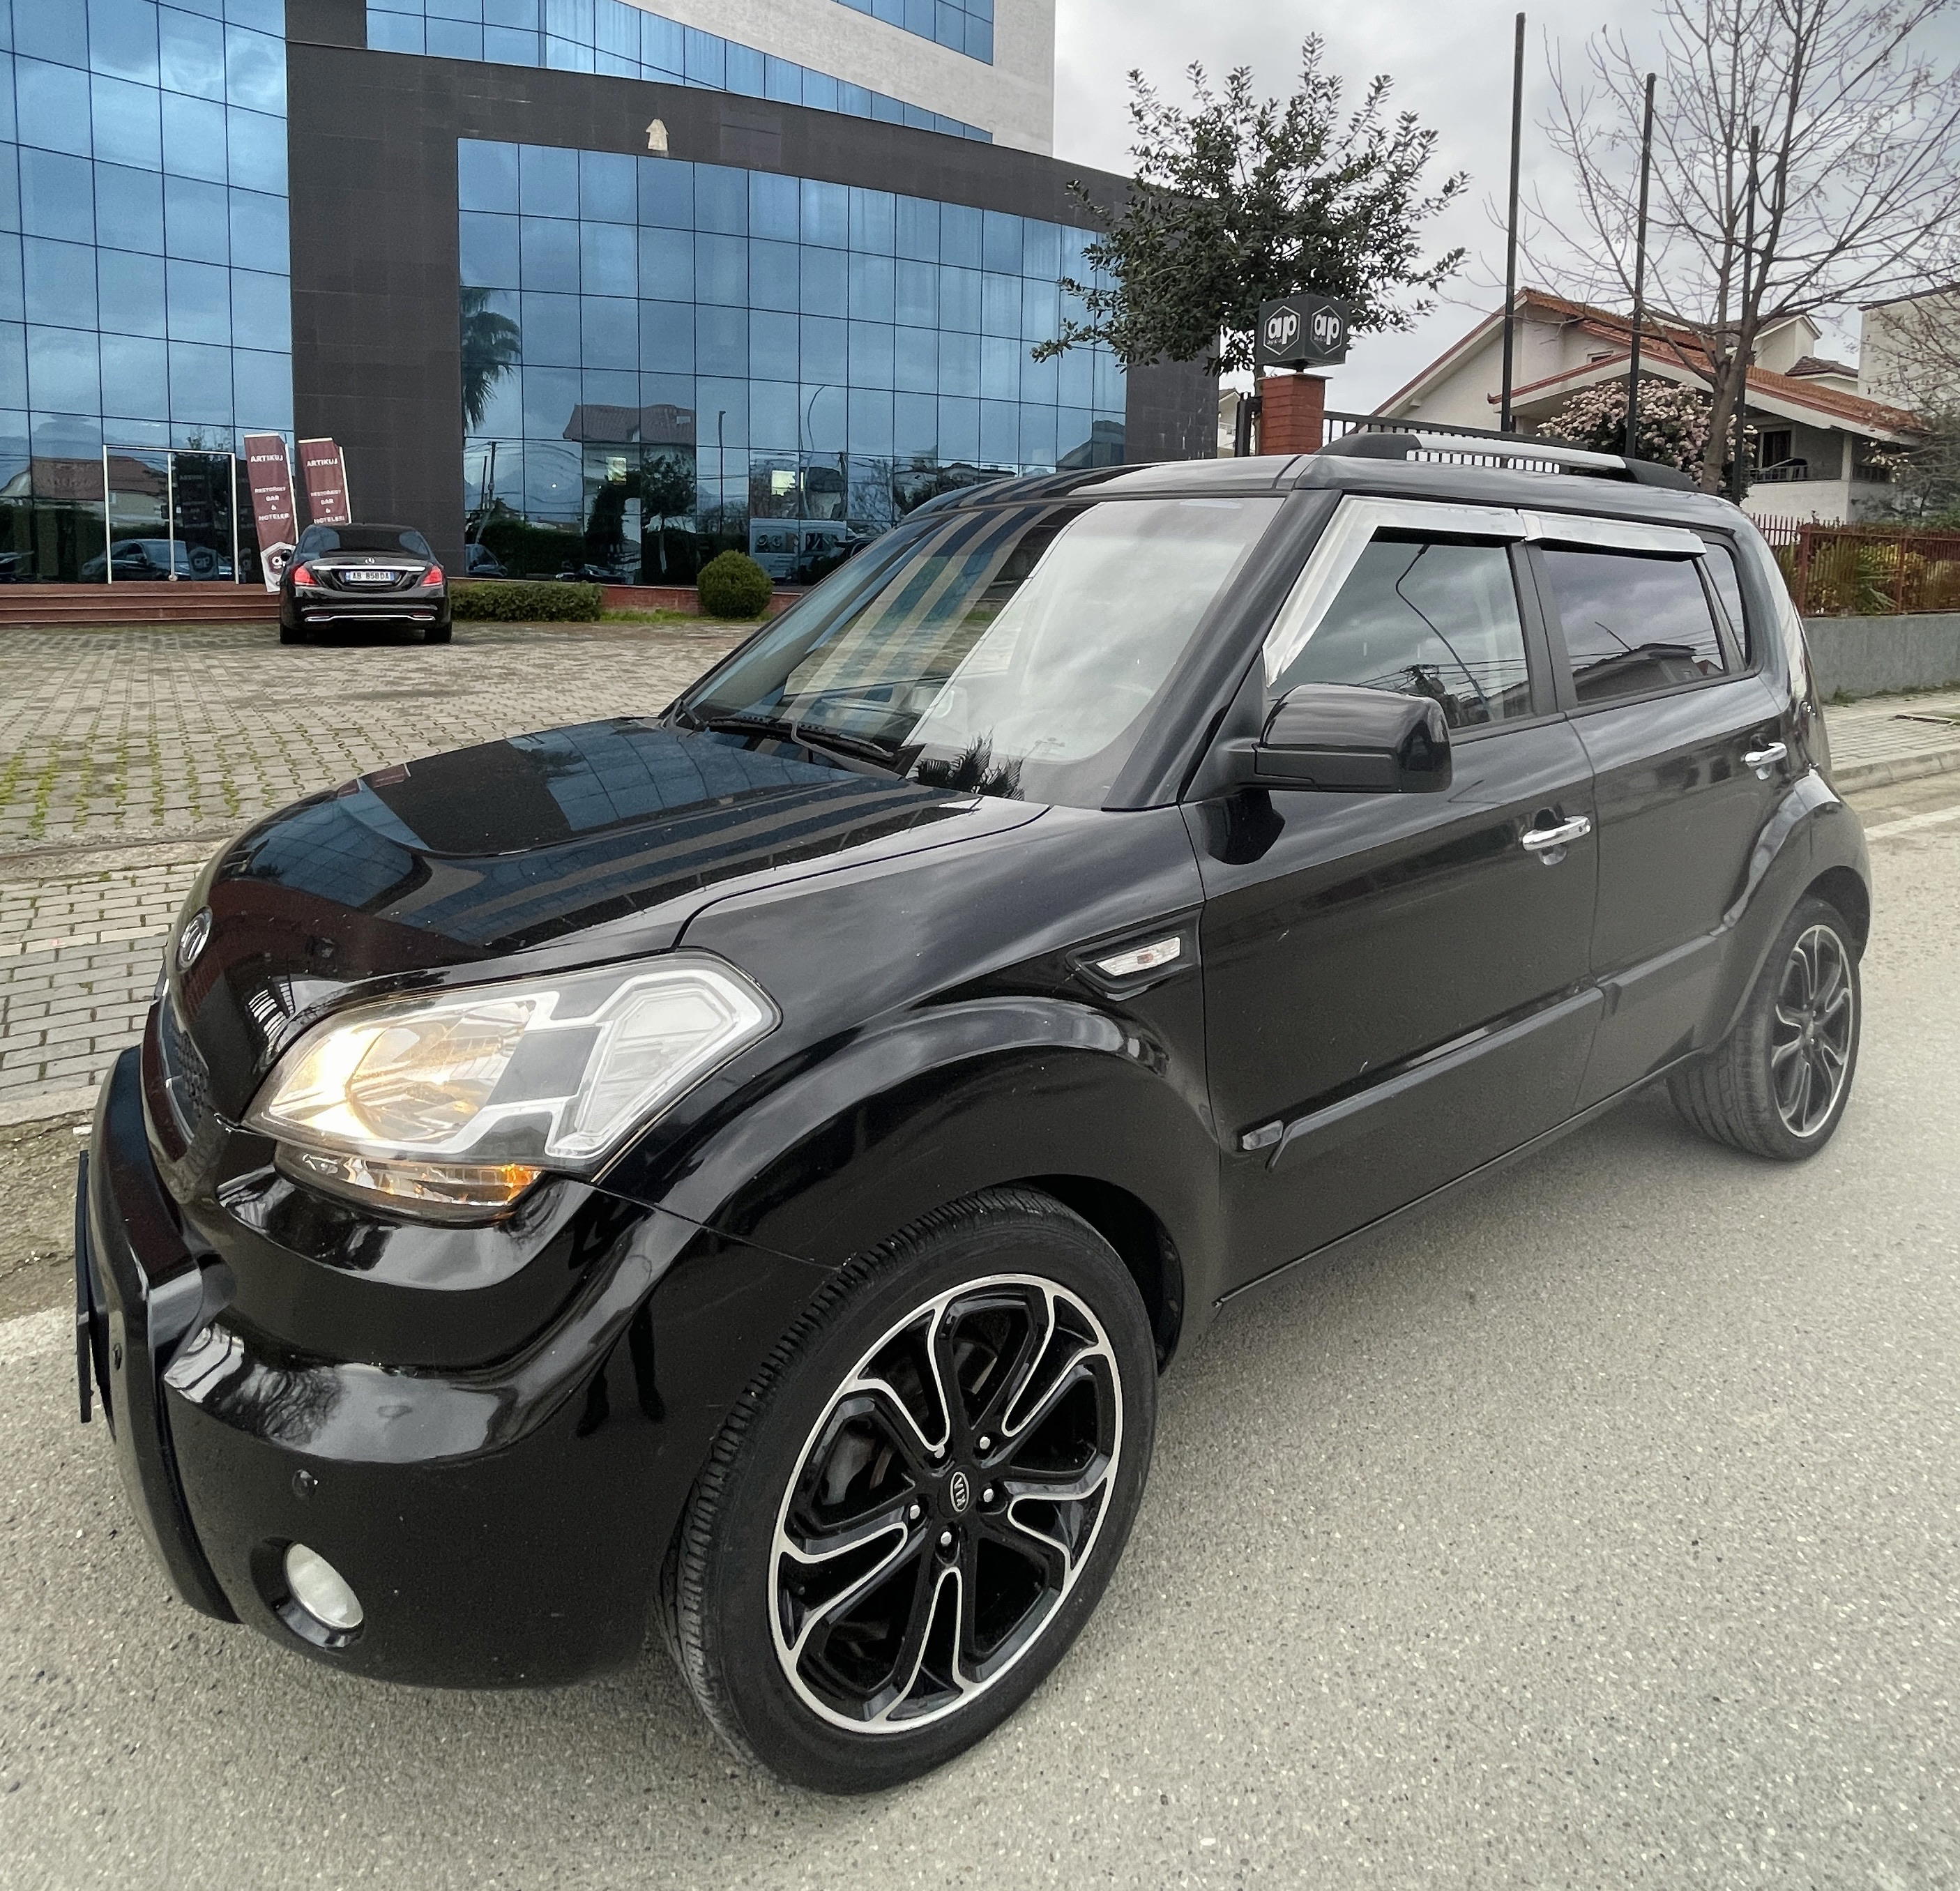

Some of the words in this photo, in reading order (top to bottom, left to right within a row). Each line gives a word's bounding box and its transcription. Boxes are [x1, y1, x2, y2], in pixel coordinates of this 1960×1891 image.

[1268, 314, 1297, 344] ap
[1314, 314, 1339, 345] ap
[250, 454, 284, 462] ARTIKUJ
[307, 458, 338, 466] ARTIKUJ
